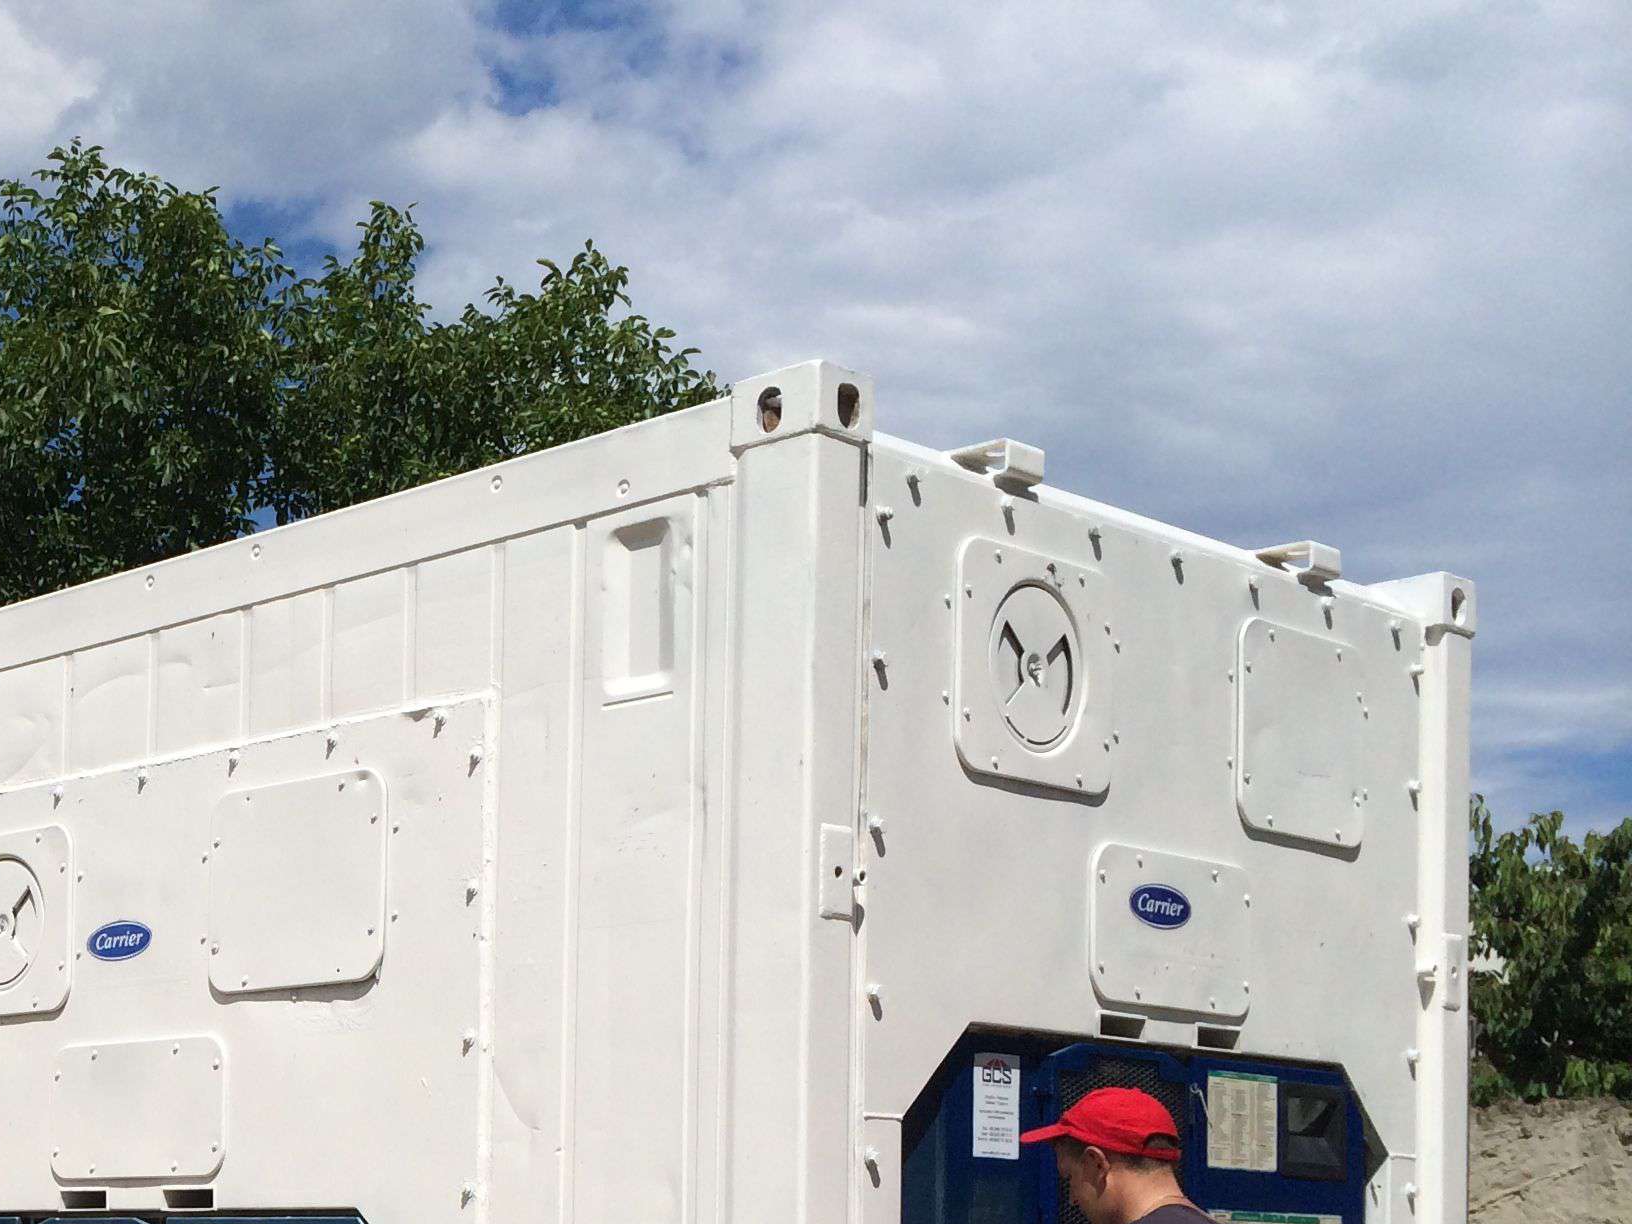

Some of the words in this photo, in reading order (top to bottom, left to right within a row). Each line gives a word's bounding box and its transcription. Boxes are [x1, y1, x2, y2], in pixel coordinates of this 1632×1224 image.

[1137, 893, 1184, 917] Carrier
[96, 931, 143, 950] Carrier
[982, 1067, 1012, 1084] GCS
